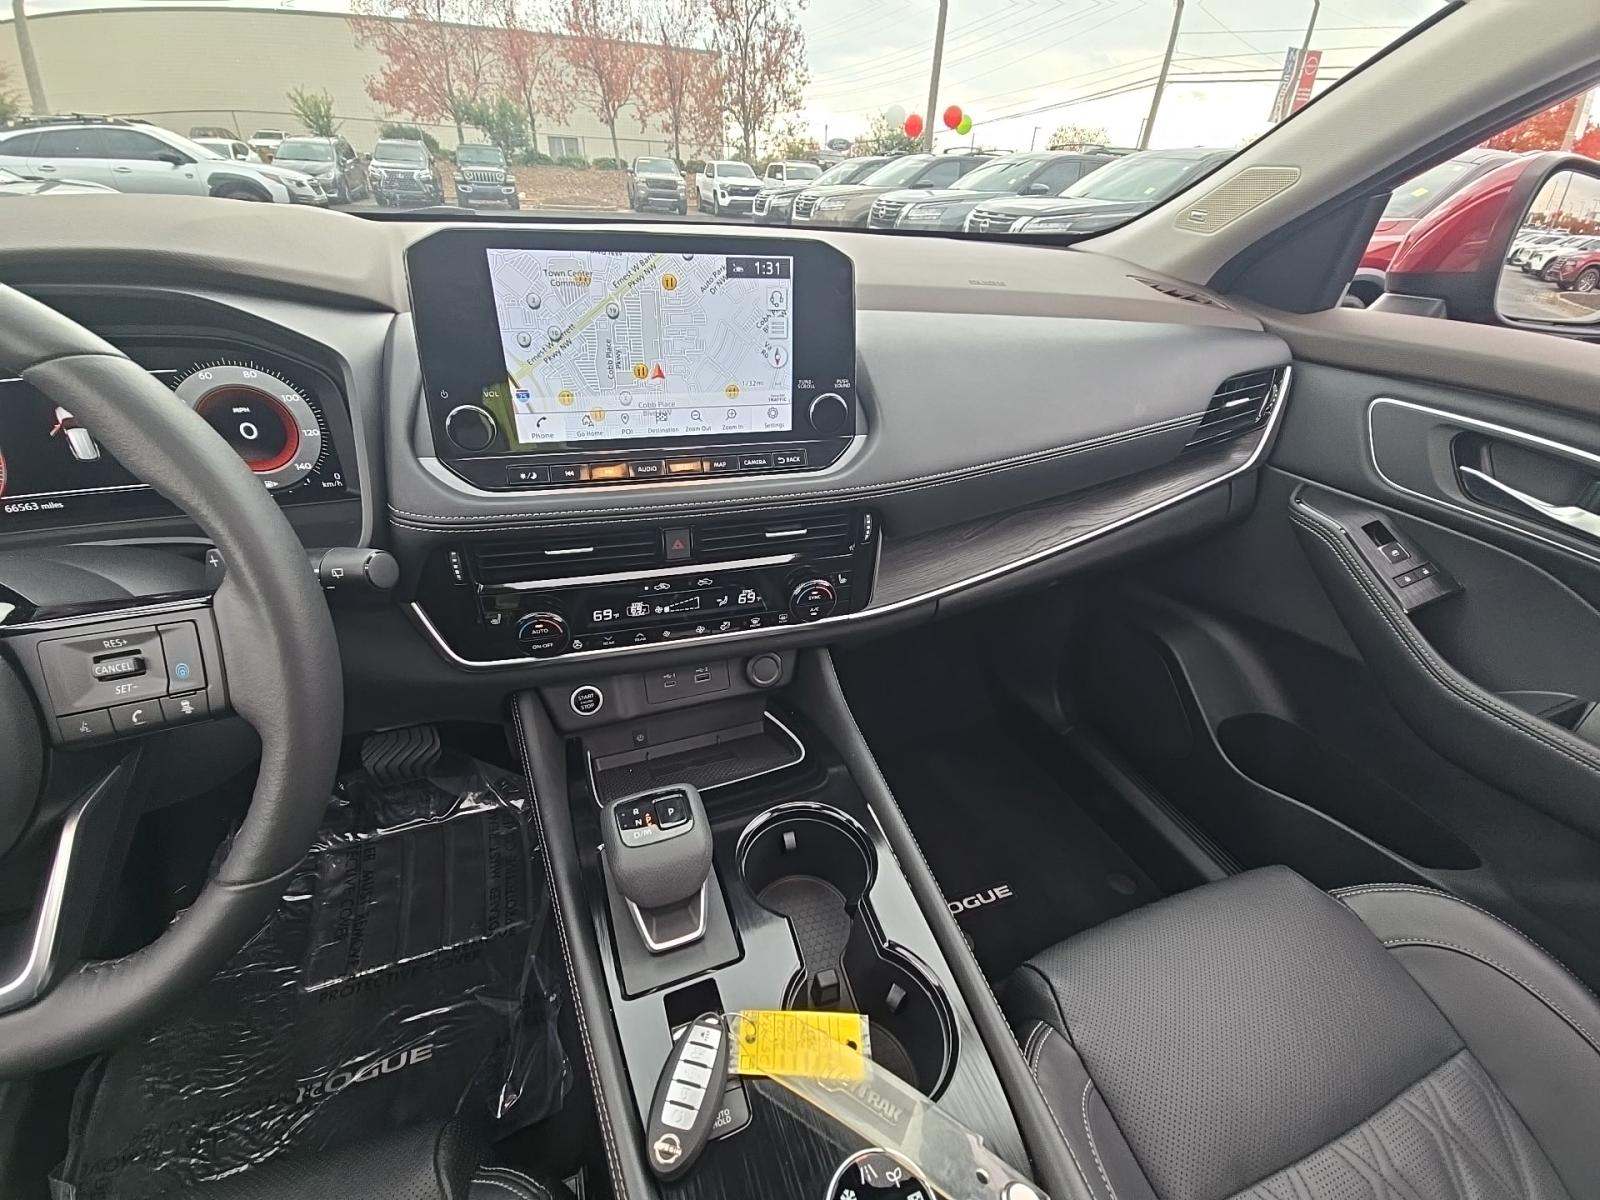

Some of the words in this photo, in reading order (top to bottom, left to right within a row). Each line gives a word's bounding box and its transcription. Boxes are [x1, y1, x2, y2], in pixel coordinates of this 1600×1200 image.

[754, 261, 782, 276] 1:31
[544, 269, 566, 278] Town
[567, 269, 593, 278] Center
[700, 275, 714, 293] Auto
[199, 371, 213, 380] 60
[242, 370, 258, 378] 80
[281, 393, 301, 402] 100
[239, 421, 258, 440] 0
[302, 429, 320, 437] 120
[295, 462, 312, 471] 140
[333, 472, 341, 480] 0
[321, 480, 343, 488] km/h
[4, 502, 39, 513] 66563
[40, 501, 64, 510] miles
[738, 591, 756, 604] 69
[593, 609, 613, 622] 69
[102, 637, 128, 649] RES+
[94, 661, 134, 676] CANCEL
[578, 693, 594, 701] START
[632, 808, 640, 816] R
[667, 807, 675, 816] P
[635, 818, 643, 827] N
[947, 884, 1013, 914] OGUE
